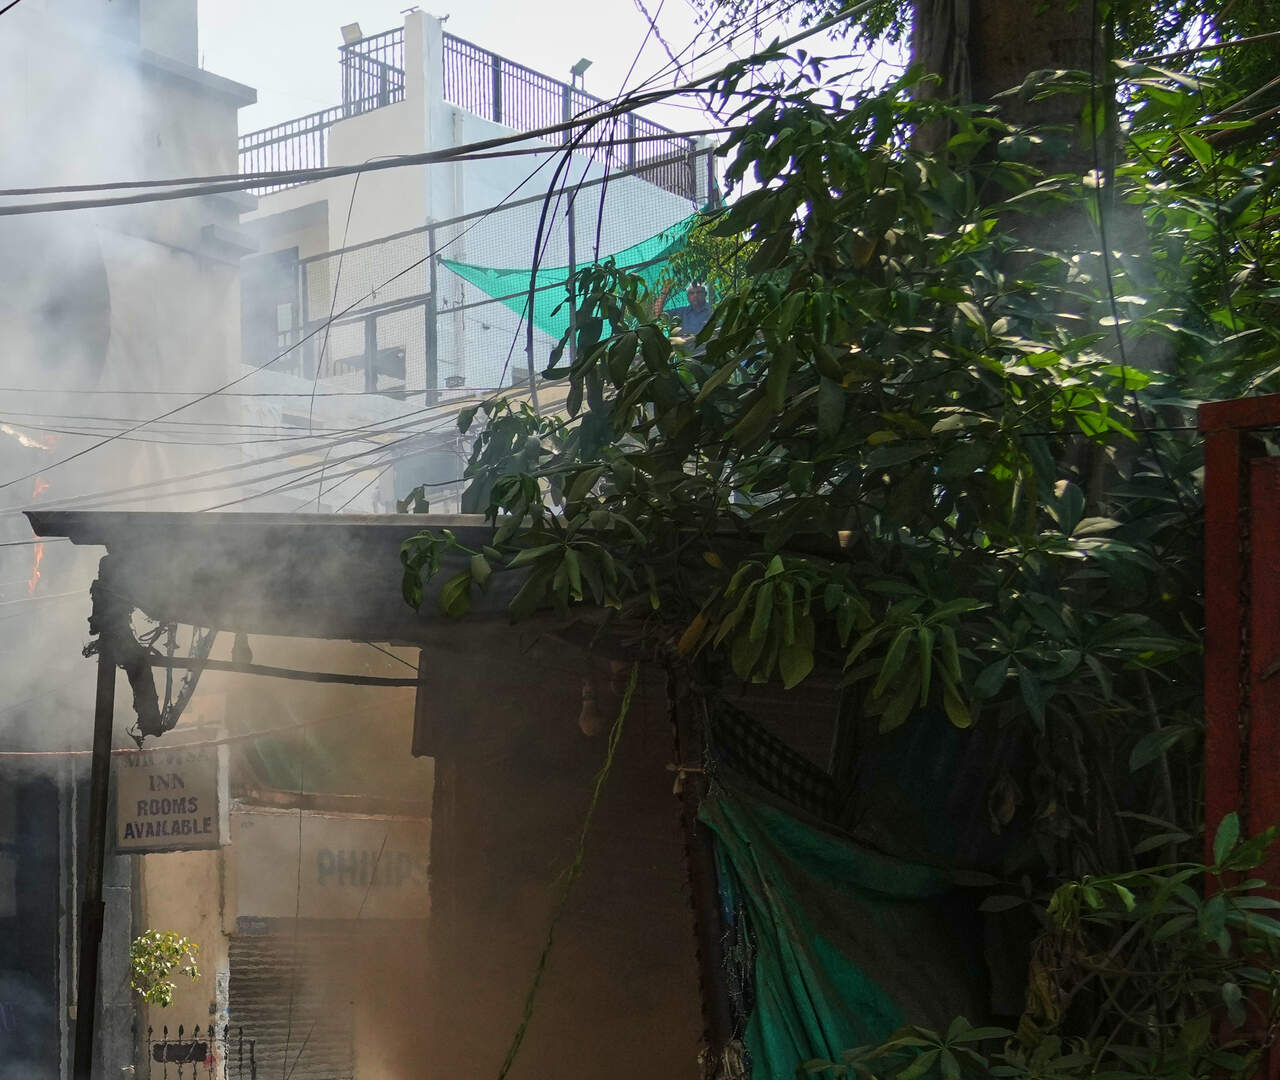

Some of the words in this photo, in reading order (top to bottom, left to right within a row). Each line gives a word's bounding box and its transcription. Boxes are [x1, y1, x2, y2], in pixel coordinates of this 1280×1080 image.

[148, 772, 185, 791] INN
[137, 796, 198, 816] ROOMS
[123, 817, 213, 840] AVAILABLE
